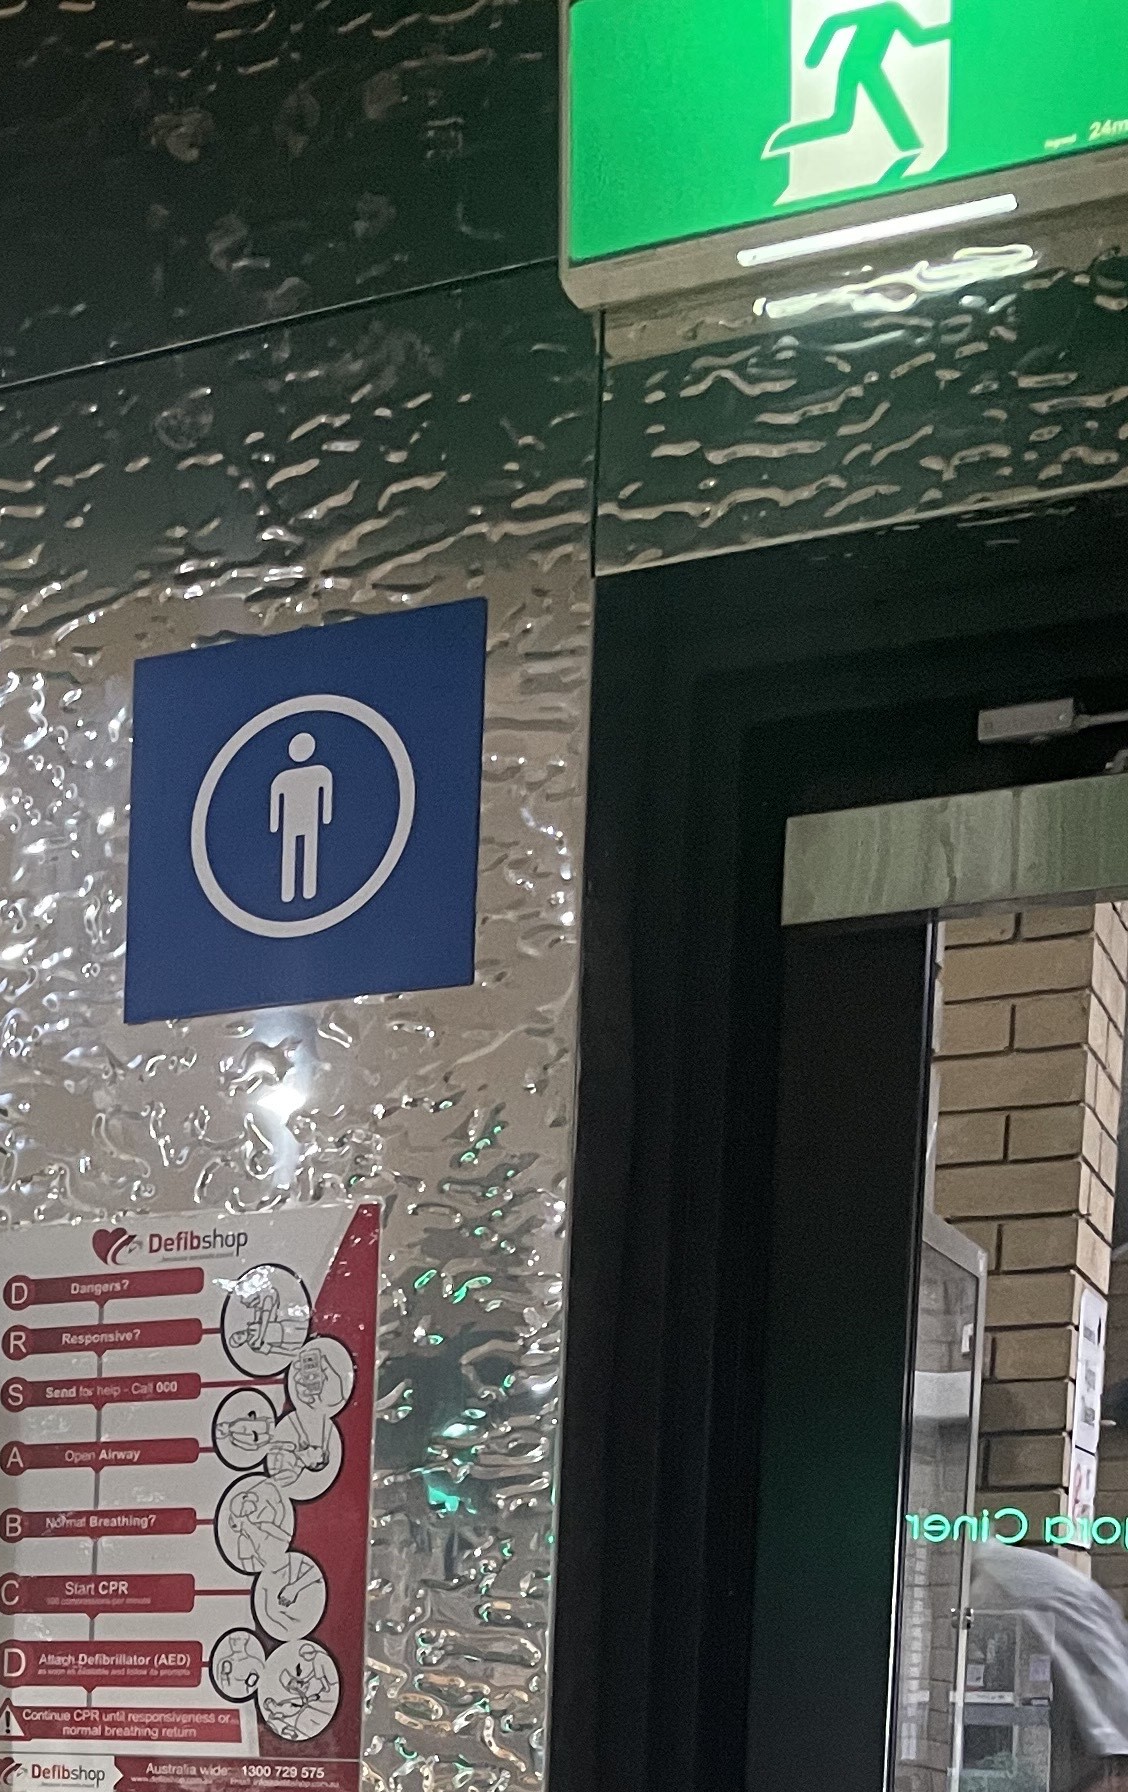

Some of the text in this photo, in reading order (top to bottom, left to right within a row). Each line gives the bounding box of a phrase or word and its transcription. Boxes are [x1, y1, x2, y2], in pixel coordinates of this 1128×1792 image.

[149, 1229, 248, 1256] Defibshop
[11, 1279, 130, 1304] D Dangers?
[10, 1329, 141, 1354] R Responsive?
[8, 1383, 24, 1406] S
[45, 1386, 77, 1399] Send
[96, 1385, 121, 1398] help
[131, 1382, 153, 1395] Call
[156, 1381, 178, 1393] 000
[6, 1446, 141, 1469] A Open Airway
[5, 1514, 157, 1537] B Normal Breathing?
[1, 1579, 129, 1605] C Start CPR
[3, 1648, 191, 1677] D Attach Defibrillator (AED)
[22, 1709, 71, 1722] Continue
[73, 1709, 100, 1722] CPR
[102, 1710, 126, 1722] until
[127, 1711, 216, 1726] responsiveness
[62, 1725, 197, 1740] normal breathing return
[31, 1763, 105, 1788] Defibshop
[145, 1762, 197, 1776] Australia
[242, 1764, 271, 1777] 1300
[274, 1766, 298, 1778] 729
[300, 1766, 325, 1779] 575
